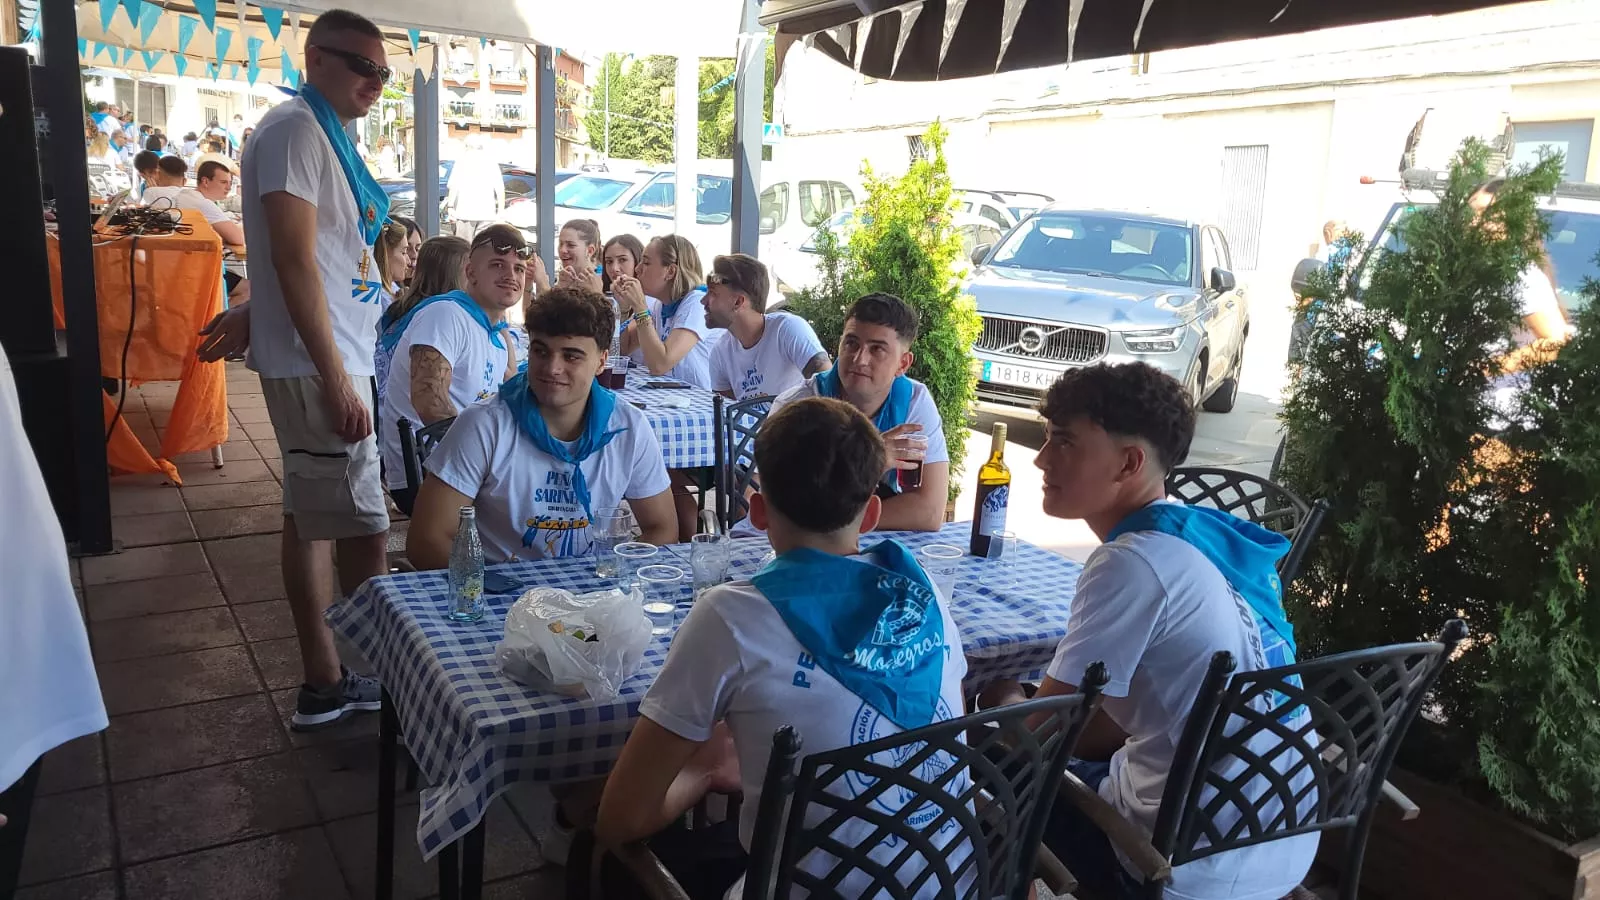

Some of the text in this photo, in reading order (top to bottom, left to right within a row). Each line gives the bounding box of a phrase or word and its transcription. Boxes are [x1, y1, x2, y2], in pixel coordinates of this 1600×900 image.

[997, 367, 1056, 386] 1818 KH
[546, 471, 572, 487] PEÑ
[792, 651, 818, 689] PE
[858, 707, 872, 744] ACIÓN
[904, 807, 942, 827] ARIÑENA
